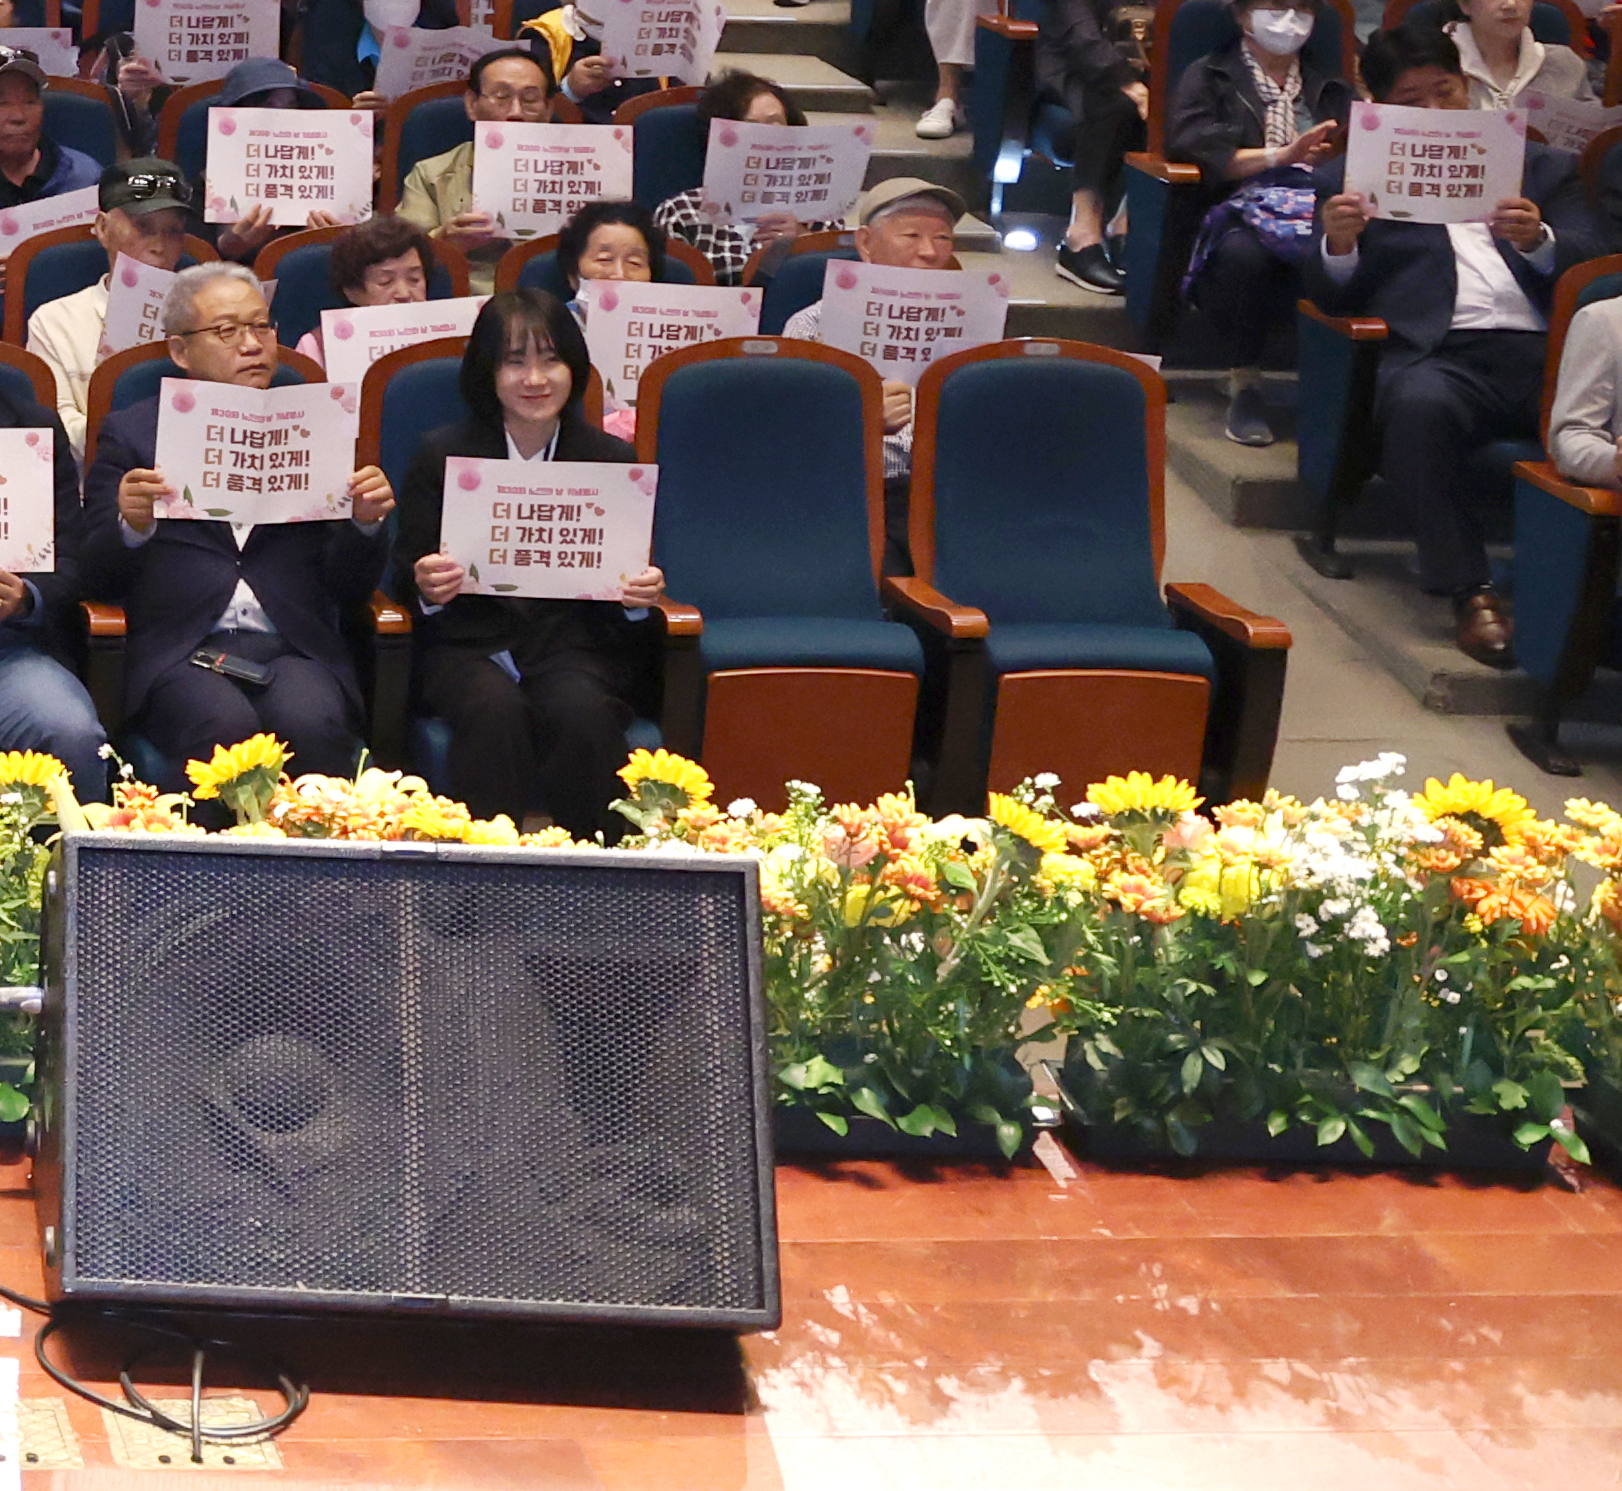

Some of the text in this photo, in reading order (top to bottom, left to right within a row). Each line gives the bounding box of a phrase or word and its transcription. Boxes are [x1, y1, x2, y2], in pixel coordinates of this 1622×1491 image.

[246, 144, 315, 160] 더 나답게!
[246, 164, 334, 180] 더 가치 있게!
[246, 183, 334, 200] 더 품격 있게!
[206, 425, 289, 448] 더 나답게!
[204, 448, 309, 470] 더 가치 있게!
[202, 472, 308, 495] 더 품격 있게!
[492, 503, 582, 522] 더 나답게!
[491, 526, 604, 545] 더 가치 있게!
[489, 548, 602, 569] 더 품격 있게!
